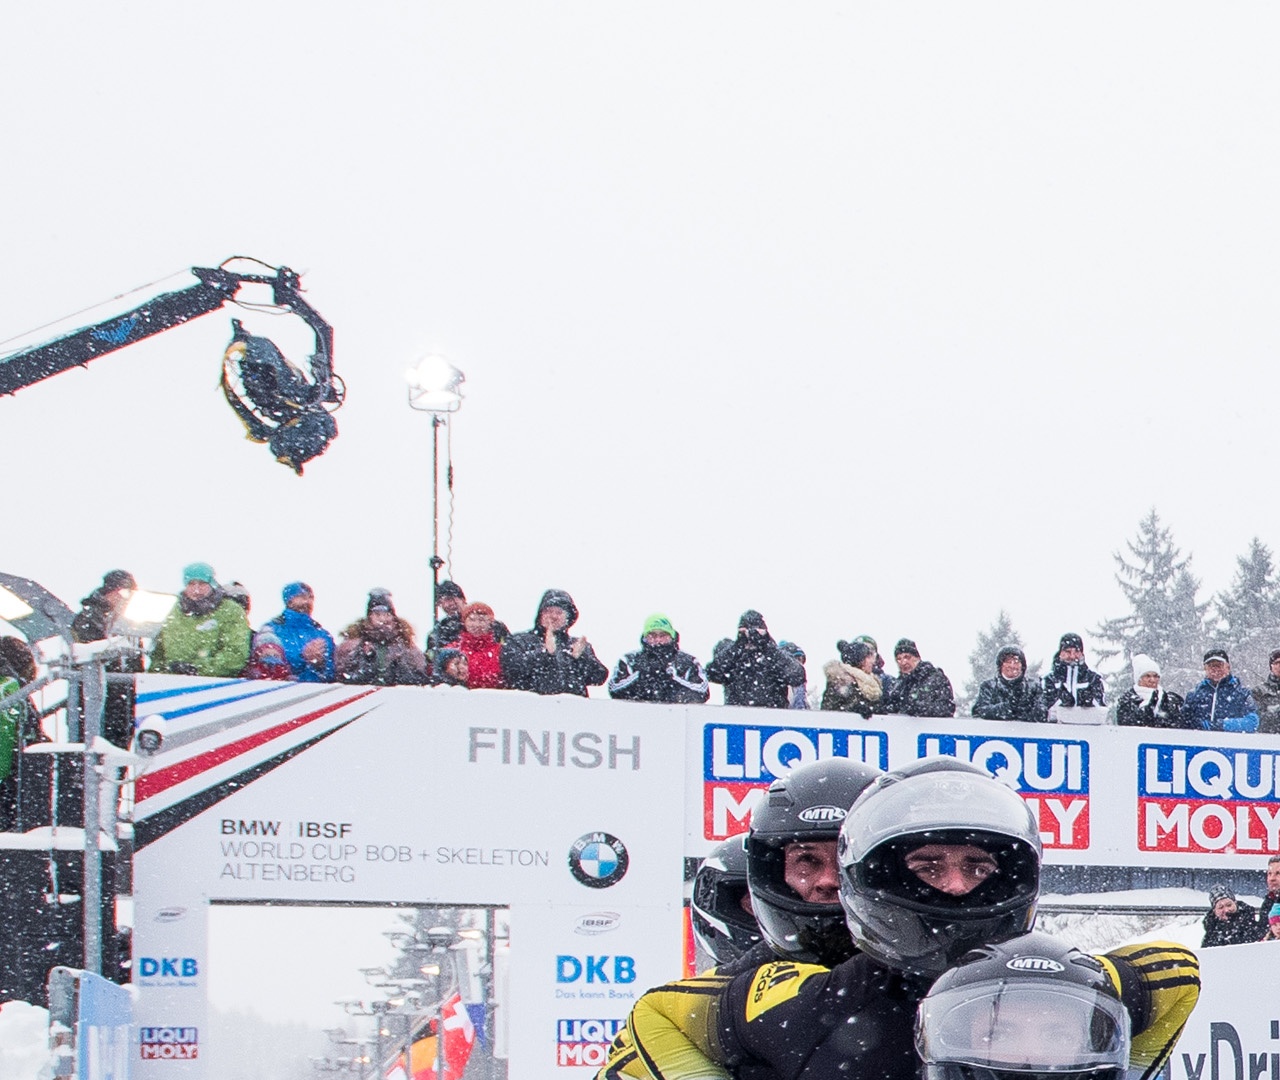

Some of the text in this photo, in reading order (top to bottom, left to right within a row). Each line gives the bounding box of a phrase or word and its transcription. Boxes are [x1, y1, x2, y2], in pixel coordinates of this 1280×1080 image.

[468, 726, 641, 770] FINISH
[926, 738, 1082, 791] QUI
[220, 819, 353, 839] BMW IBSF
[220, 841, 305, 860] WORLD
[311, 843, 358, 861] CUP
[366, 845, 412, 863] BOB
[436, 847, 549, 867] SKELETON
[219, 862, 356, 883] ALTENBERG
[139, 958, 198, 977] DKB
[556, 955, 636, 984] DKB
[142, 1029, 196, 1043] LIQUI
[560, 1020, 624, 1042] LIQU
[142, 1044, 197, 1059] MOLY
[560, 1044, 609, 1066] MO
